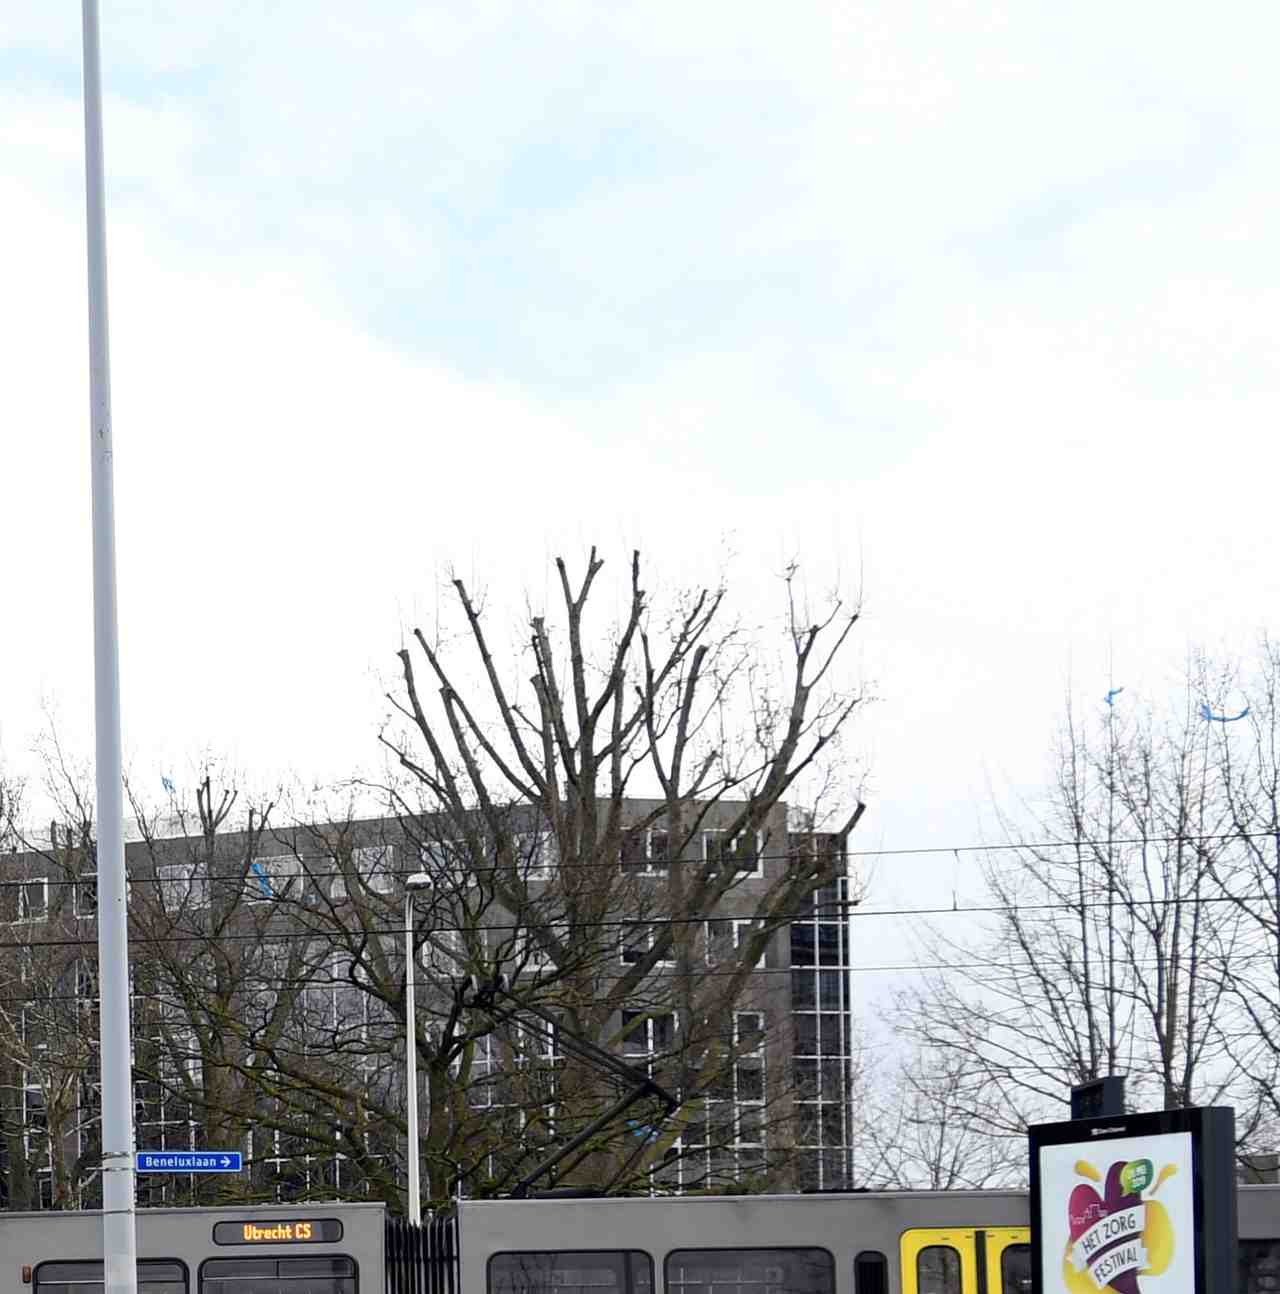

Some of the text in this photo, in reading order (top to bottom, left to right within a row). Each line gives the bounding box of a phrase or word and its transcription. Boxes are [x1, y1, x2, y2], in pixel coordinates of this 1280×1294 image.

[144, 1156, 217, 1168] Beneluxlaan
[243, 1223, 312, 1241] Utrecht CS
[1081, 1213, 1136, 1255] HET ZORG
[1094, 1247, 1138, 1283] FESTIVAL
